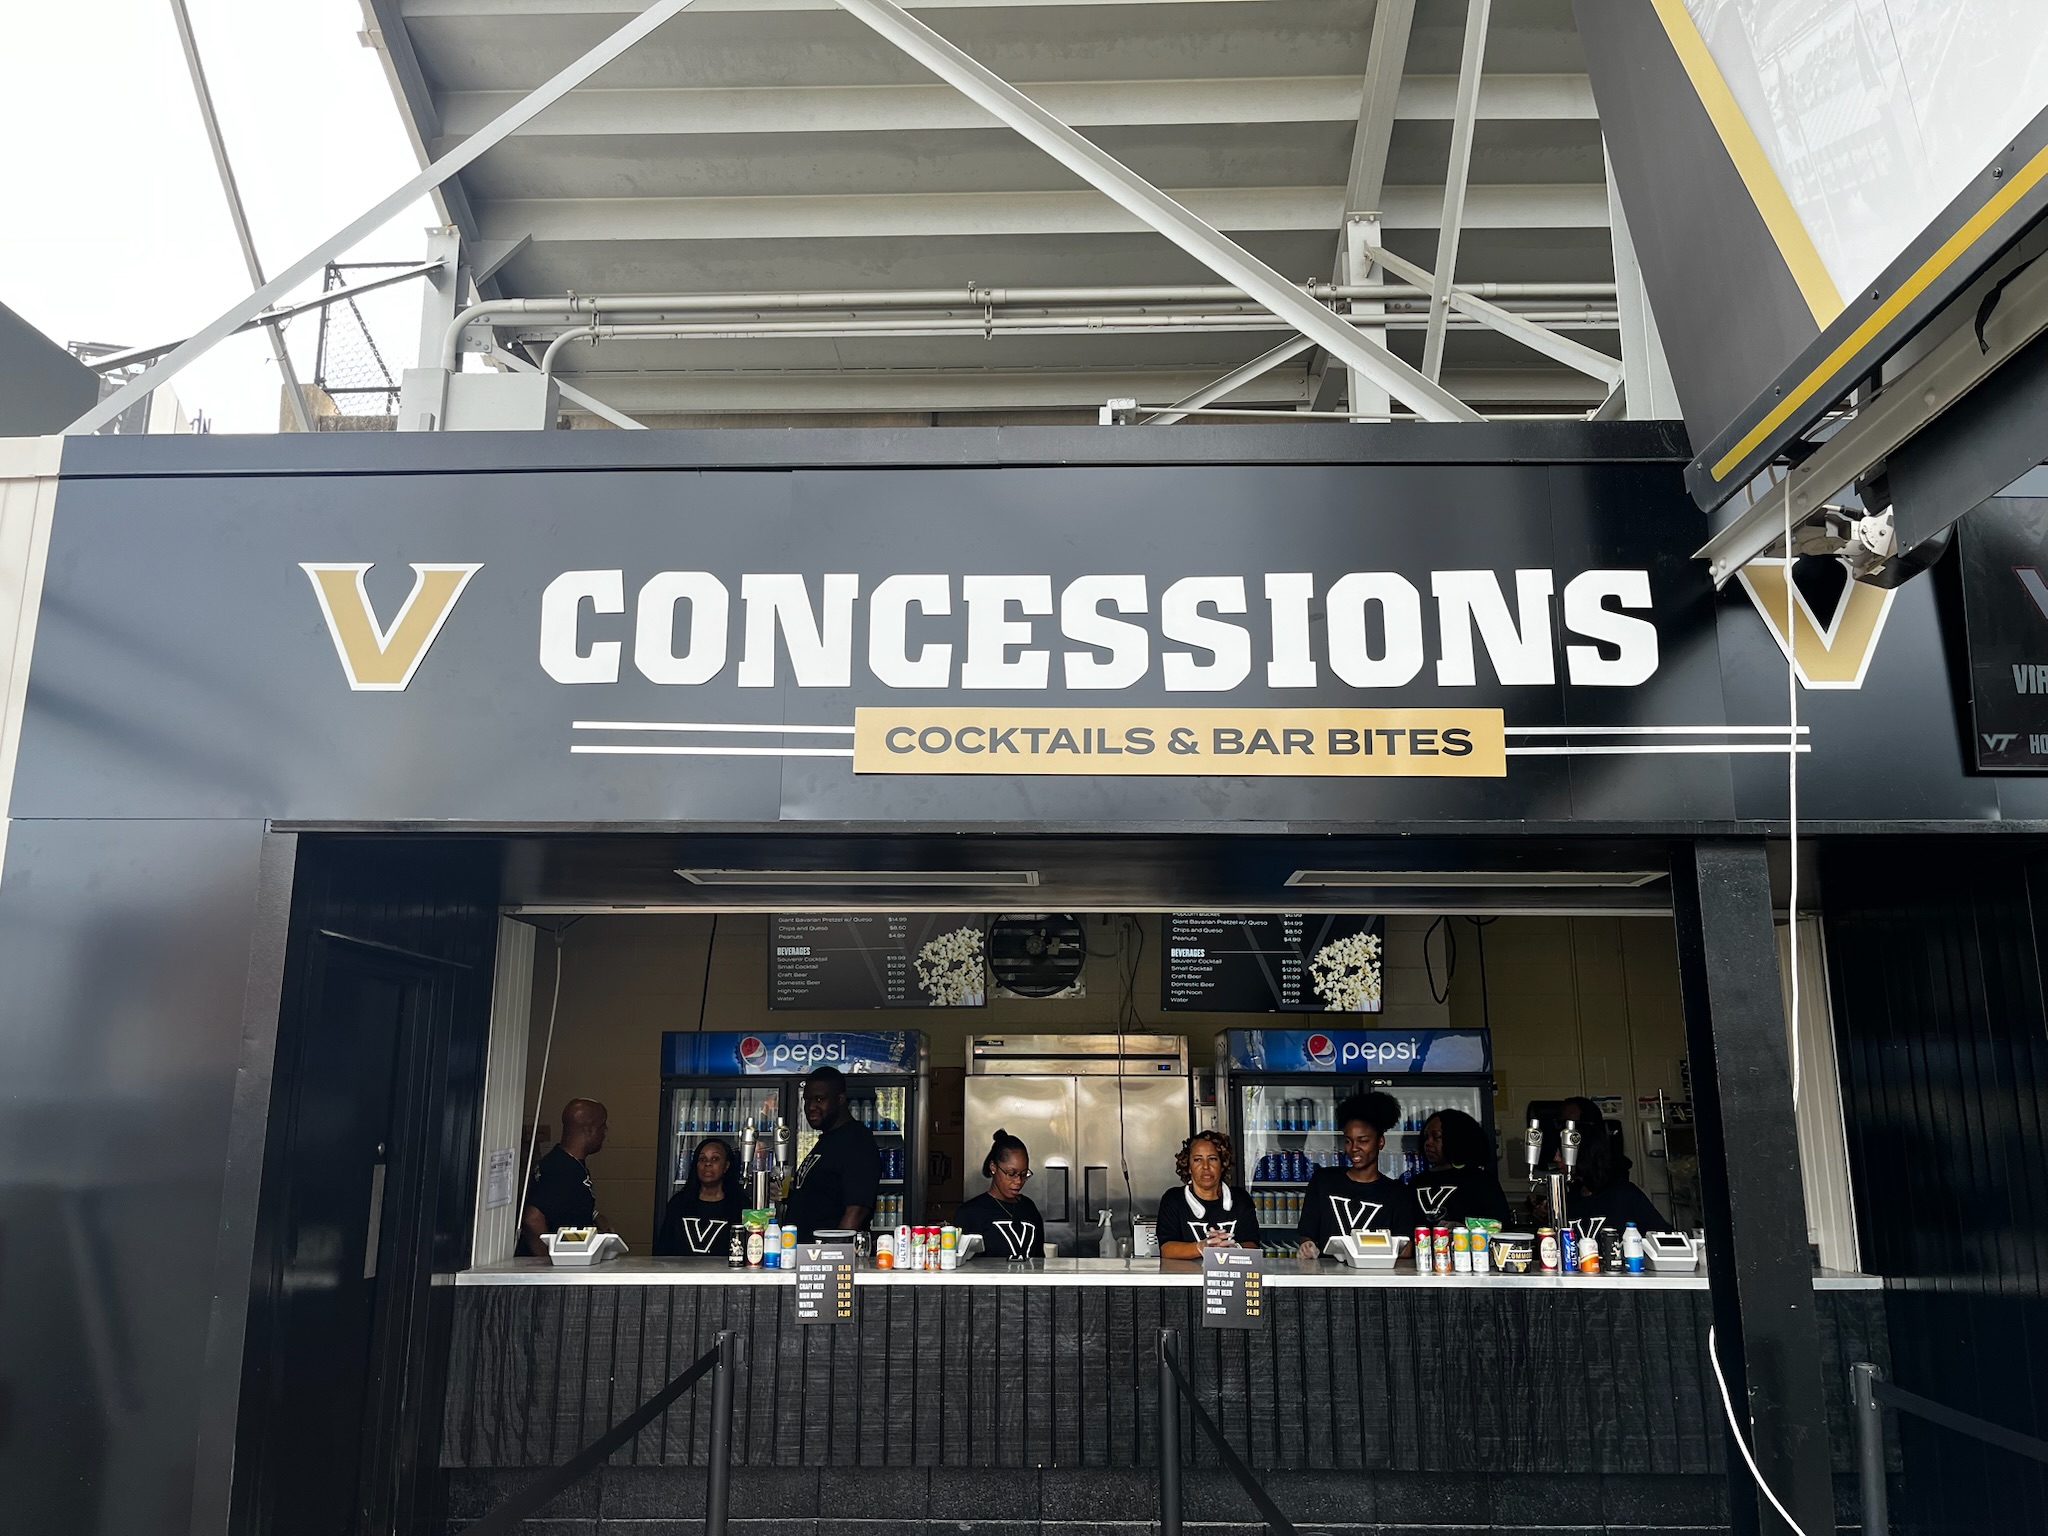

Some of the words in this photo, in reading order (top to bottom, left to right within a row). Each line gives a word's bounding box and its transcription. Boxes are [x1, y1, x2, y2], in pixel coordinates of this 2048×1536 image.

[298, 562, 485, 691] V
[539, 568, 1660, 691] CONCESSIONS
[884, 725, 1156, 756] COCKTAILS
[1167, 727, 1200, 756] &
[1212, 727, 1316, 757] BAR
[1327, 727, 1474, 757] BITES
[777, 947, 810, 956] BEVERAGES
[1171, 949, 1205, 958] BEVERAGES
[773, 1039, 847, 1066] pepsi
[1342, 1037, 1419, 1065] pepsi
[1417, 1186, 1457, 1214] V
[682, 1217, 728, 1253] V
[992, 1221, 1036, 1261] V
[807, 1249, 821, 1260] V
[1214, 1253, 1229, 1264] V
